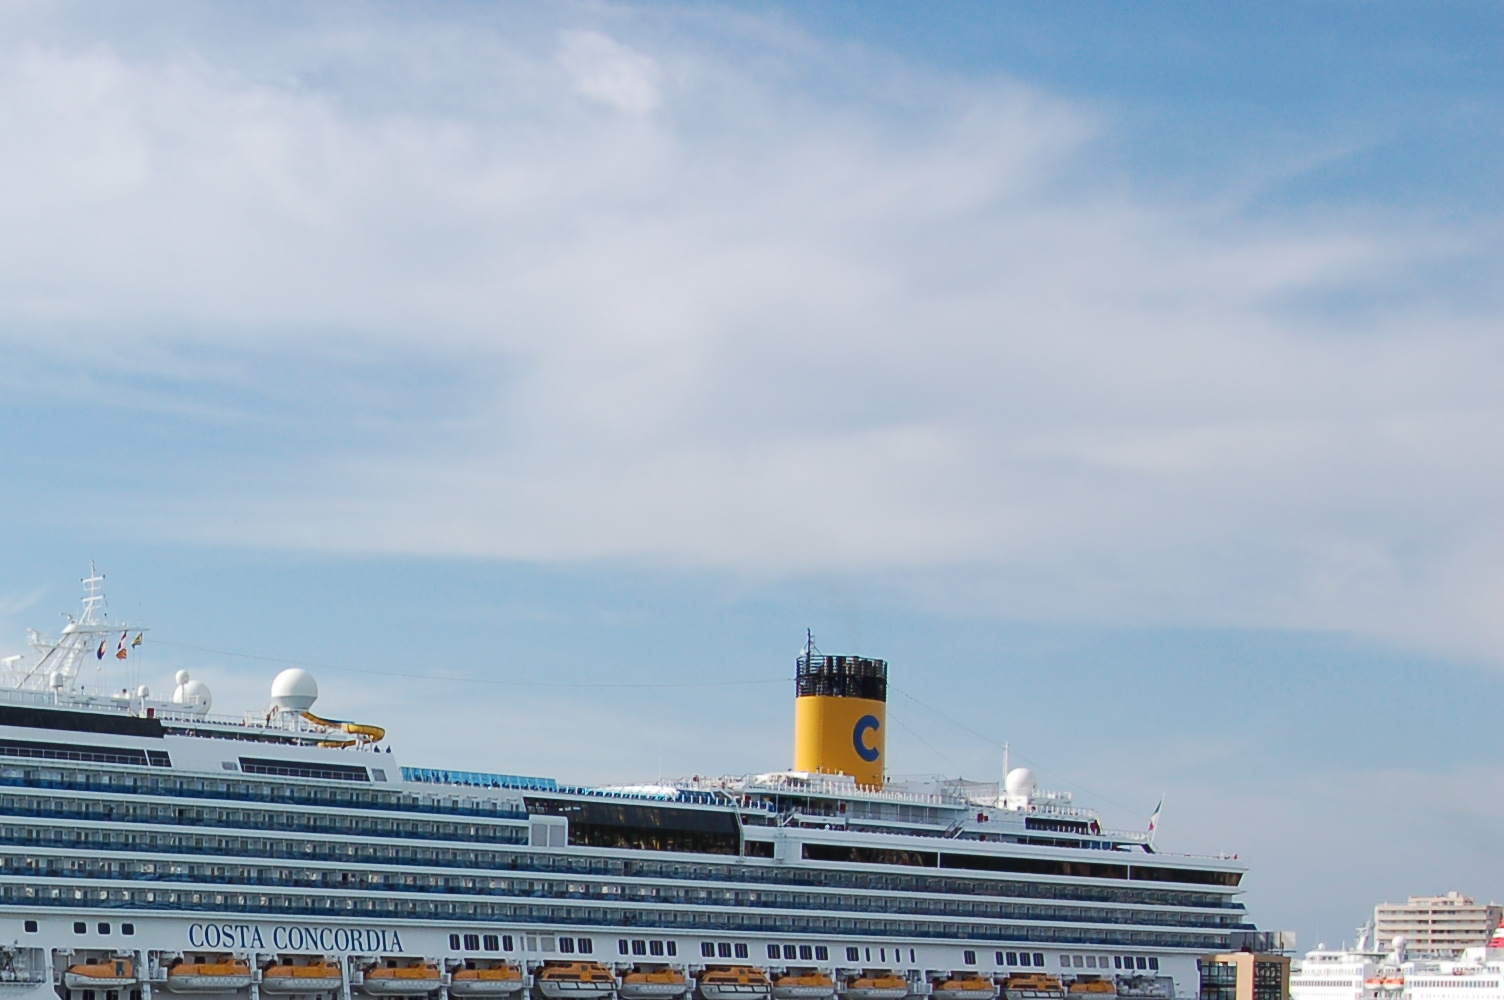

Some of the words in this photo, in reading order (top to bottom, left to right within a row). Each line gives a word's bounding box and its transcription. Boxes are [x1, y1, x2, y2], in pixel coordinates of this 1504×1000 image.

[853, 714, 880, 762] C
[188, 923, 265, 949] COSTA
[273, 926, 404, 952] CONCORDIA
